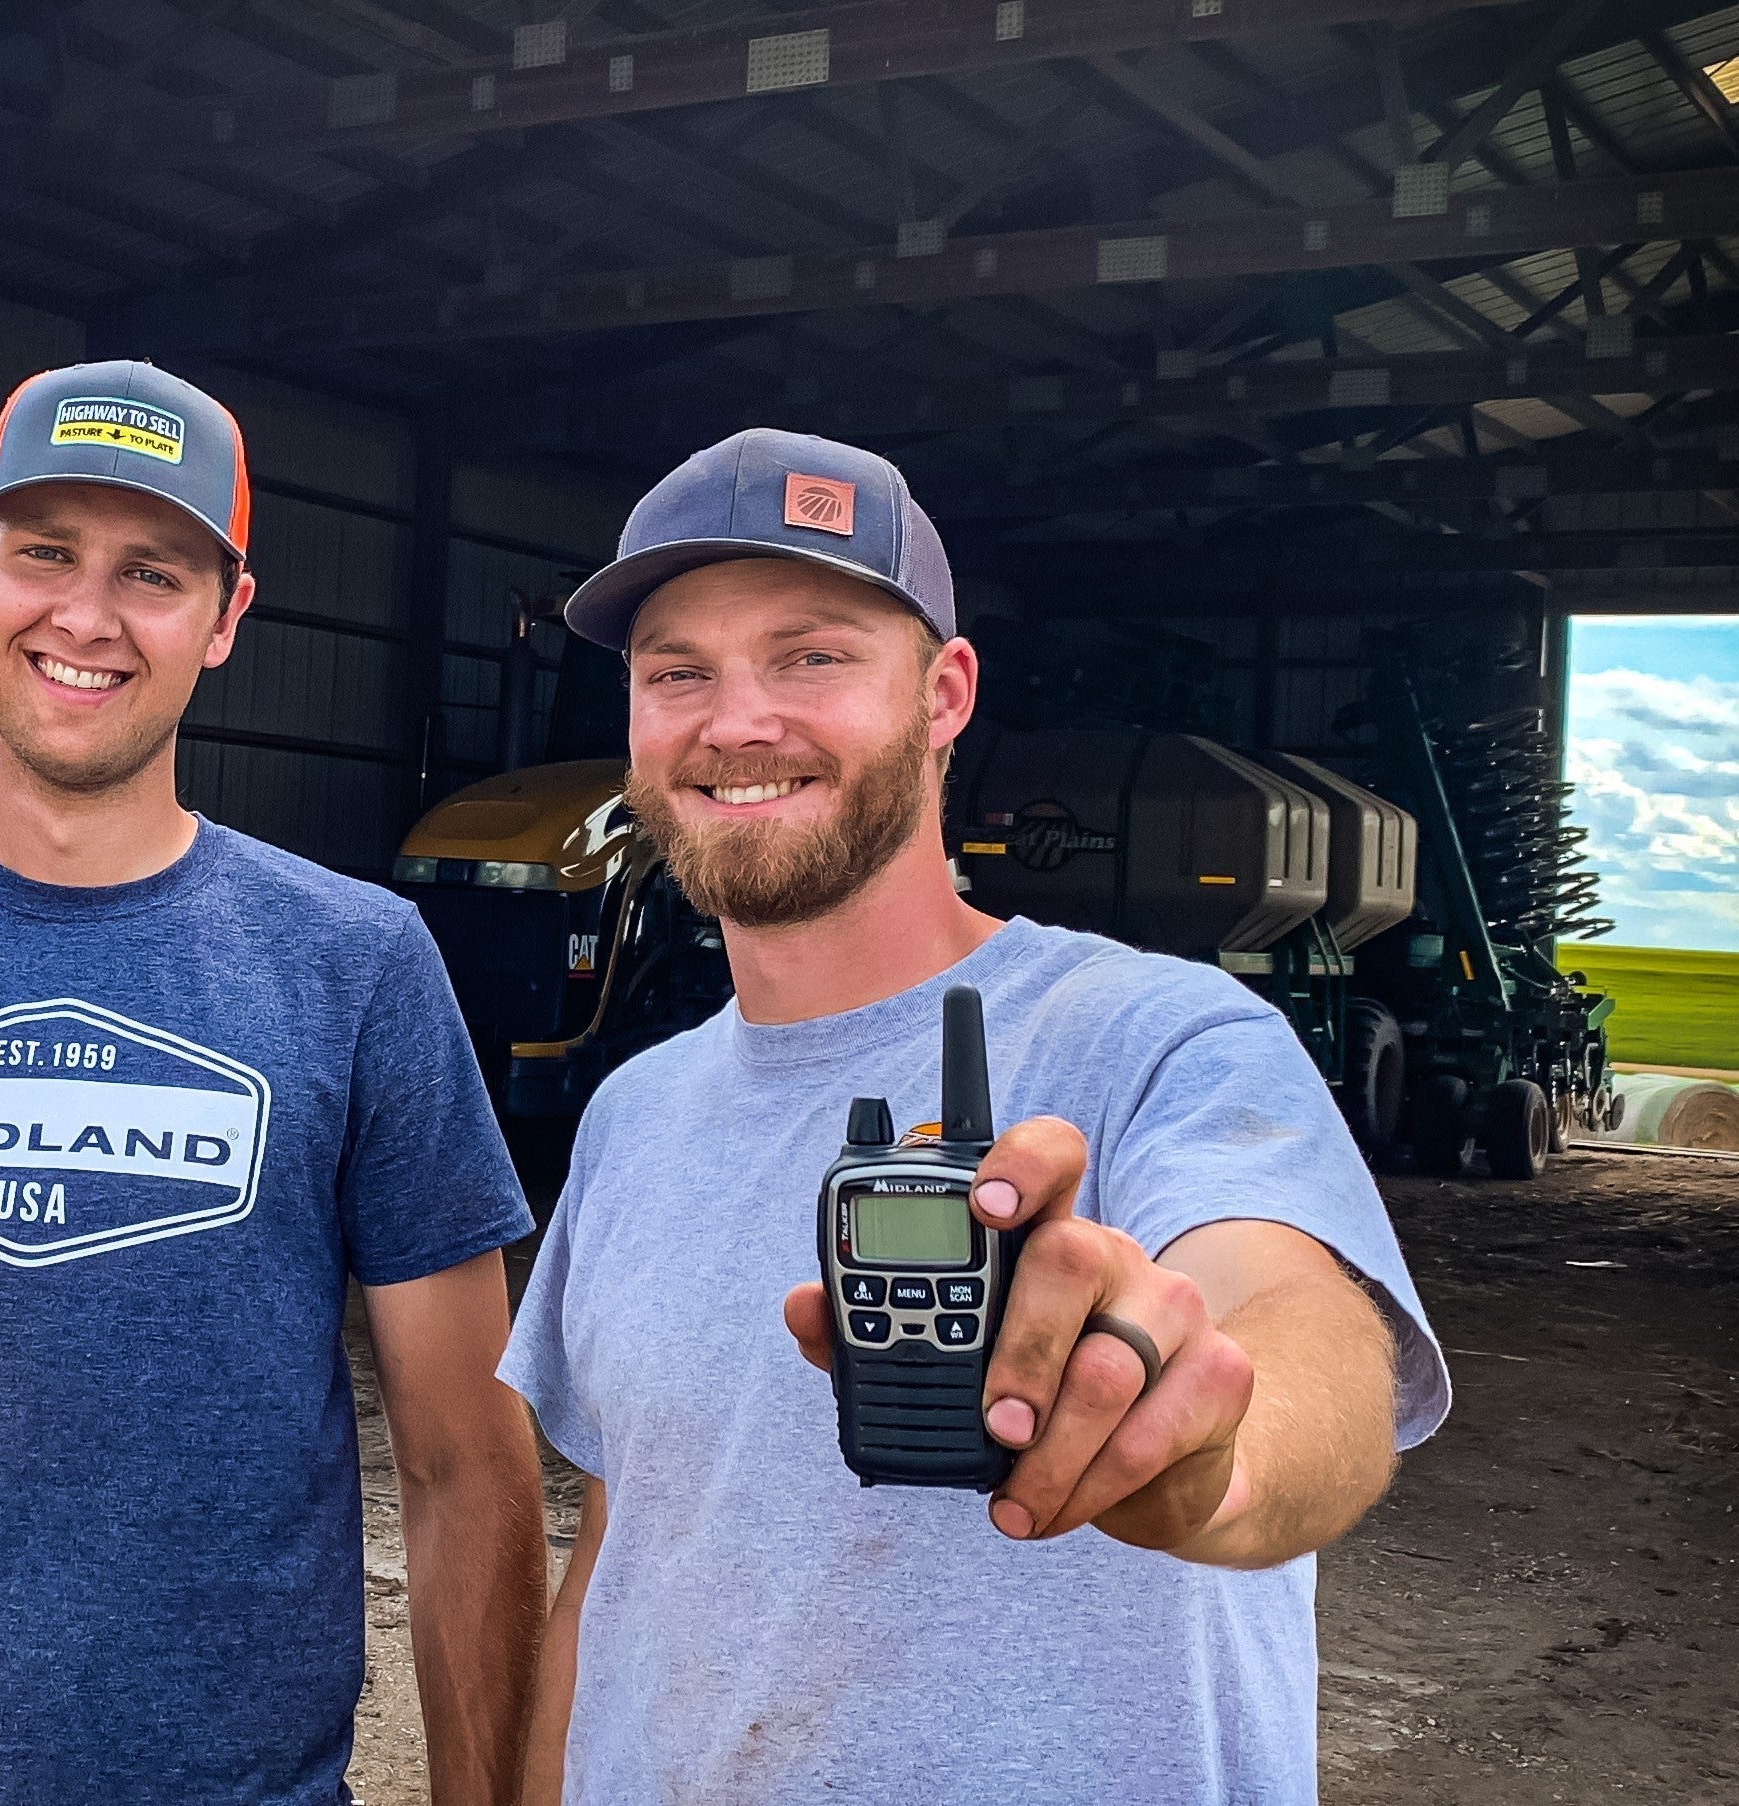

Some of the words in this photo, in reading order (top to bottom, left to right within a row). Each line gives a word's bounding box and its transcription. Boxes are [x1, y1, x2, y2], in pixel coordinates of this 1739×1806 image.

[60, 405, 127, 422] HIGHWAY
[129, 410, 147, 427] TO
[149, 416, 179, 439] SELL
[60, 428, 102, 438] PASTURE
[130, 434, 143, 444] TO
[145, 438, 174, 454] PLATE
[569, 934, 598, 970] CAT
[53, 1042, 117, 1070] 1959
[854, 1291, 873, 1301] CALL
[897, 1288, 926, 1299] MENU
[949, 1285, 972, 1294] MON
[949, 1293, 973, 1302] SCAN
